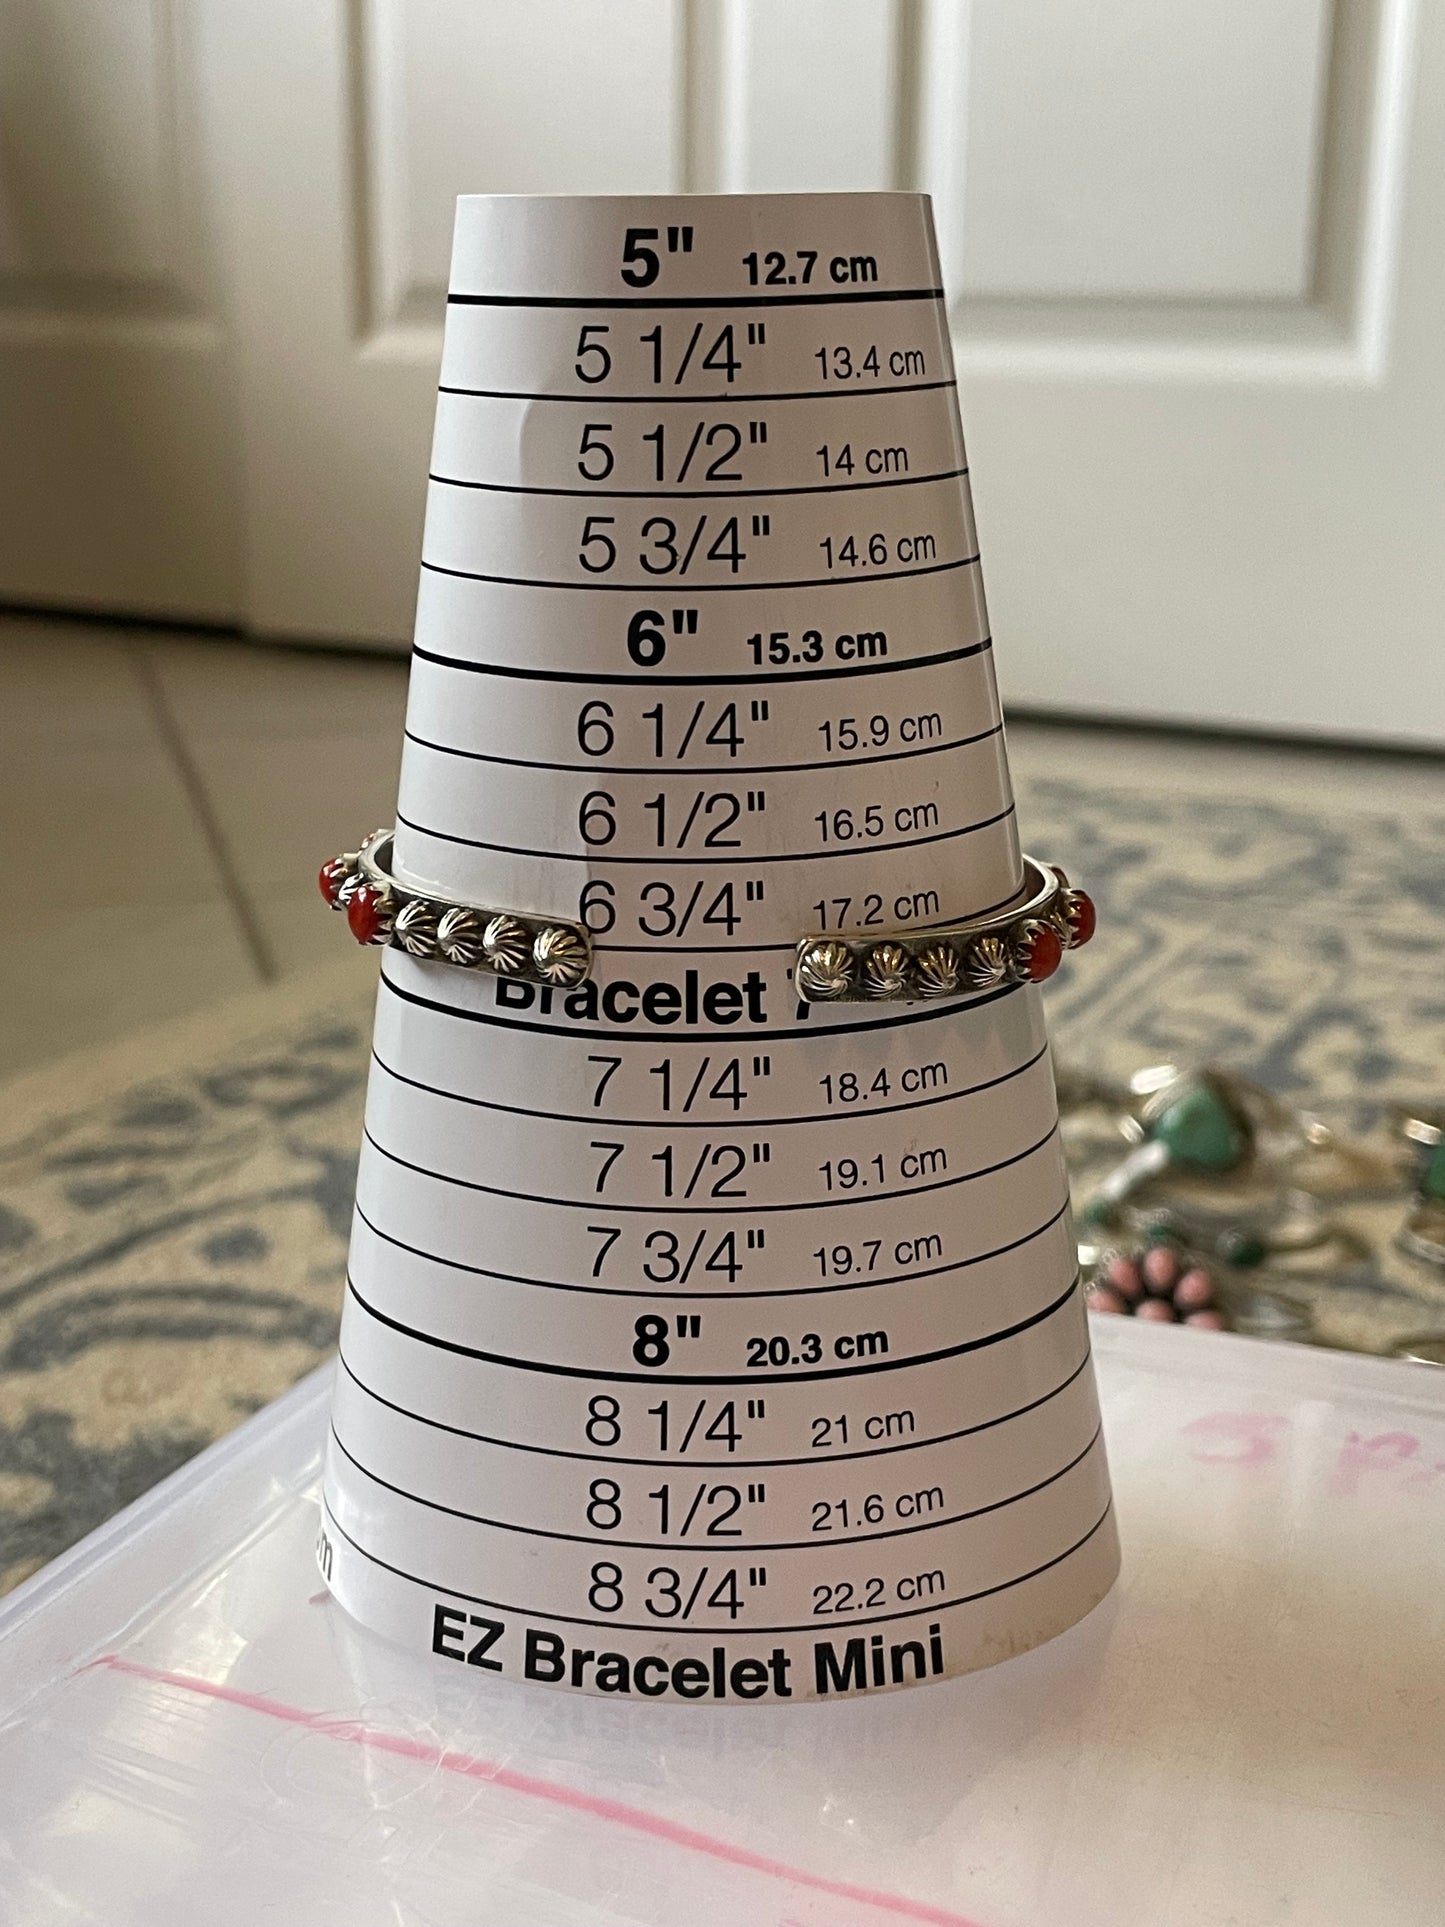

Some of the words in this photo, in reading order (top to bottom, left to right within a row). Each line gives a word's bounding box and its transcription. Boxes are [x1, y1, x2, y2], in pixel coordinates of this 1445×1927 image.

[620, 225, 694, 289] 5"
[741, 250, 818, 286] 12.7
[829, 255, 879, 284] cm
[574, 325, 612, 384] 5
[639, 322, 766, 385] 1/4"
[814, 344, 881, 380] 13.4
[888, 349, 926, 377] cm
[577, 423, 615, 482] 5
[642, 421, 768, 484] 1/2"
[815, 443, 856, 478] 14
[865, 447, 909, 475] cm
[578, 516, 617, 574] 5
[639, 514, 770, 576] 3/4"
[819, 533, 888, 570] 14.6
[896, 534, 937, 563] cm
[626, 608, 699, 668] 6"
[746, 629, 824, 666] 15.3
[834, 631, 888, 661] cm
[577, 700, 615, 757] 6
[641, 699, 769, 760] 1/4"
[817, 714, 890, 753] 15.9
[899, 712, 942, 743] cm
[578, 790, 617, 846] 6
[643, 790, 766, 849] 1/2"
[814, 804, 884, 843] 16.5
[894, 802, 939, 832] cm
[578, 881, 616, 936] 6
[638, 879, 764, 938] 3/4"
[812, 893, 885, 932] 17.2
[893, 890, 940, 921] cm
[587, 1055, 623, 1108] 7
[649, 1055, 771, 1113] 1/4"
[819, 1067, 892, 1105] 18.4
[901, 1062, 948, 1093] cm
[590, 1141, 625, 1193] 7
[651, 1142, 771, 1199] 1/2"
[818, 1153, 885, 1191] 19.1
[900, 1147, 948, 1179] cm
[586, 1225, 622, 1278] 7
[642, 1228, 765, 1285] 3/4"
[812, 1239, 882, 1277] 19.7
[894, 1234, 943, 1265] cm
[632, 1314, 702, 1368] 8"
[746, 1333, 823, 1368] 20.3
[833, 1330, 889, 1360] cm
[585, 1394, 622, 1447] 8
[647, 1399, 766, 1454] 1/4"
[811, 1414, 848, 1448] 21
[864, 1410, 915, 1440] cm
[586, 1478, 622, 1531] 8
[648, 1483, 766, 1537] 1/2"
[811, 1493, 885, 1532] 21.6
[895, 1486, 944, 1518] cm
[587, 1561, 624, 1613] 8
[644, 1566, 767, 1621] 3/4"
[812, 1577, 887, 1615] 22.2
[896, 1569, 946, 1601] cm
[431, 1603, 506, 1673] EZ
[524, 1628, 793, 1700] Bracelet
[813, 1622, 945, 1698] Mini
